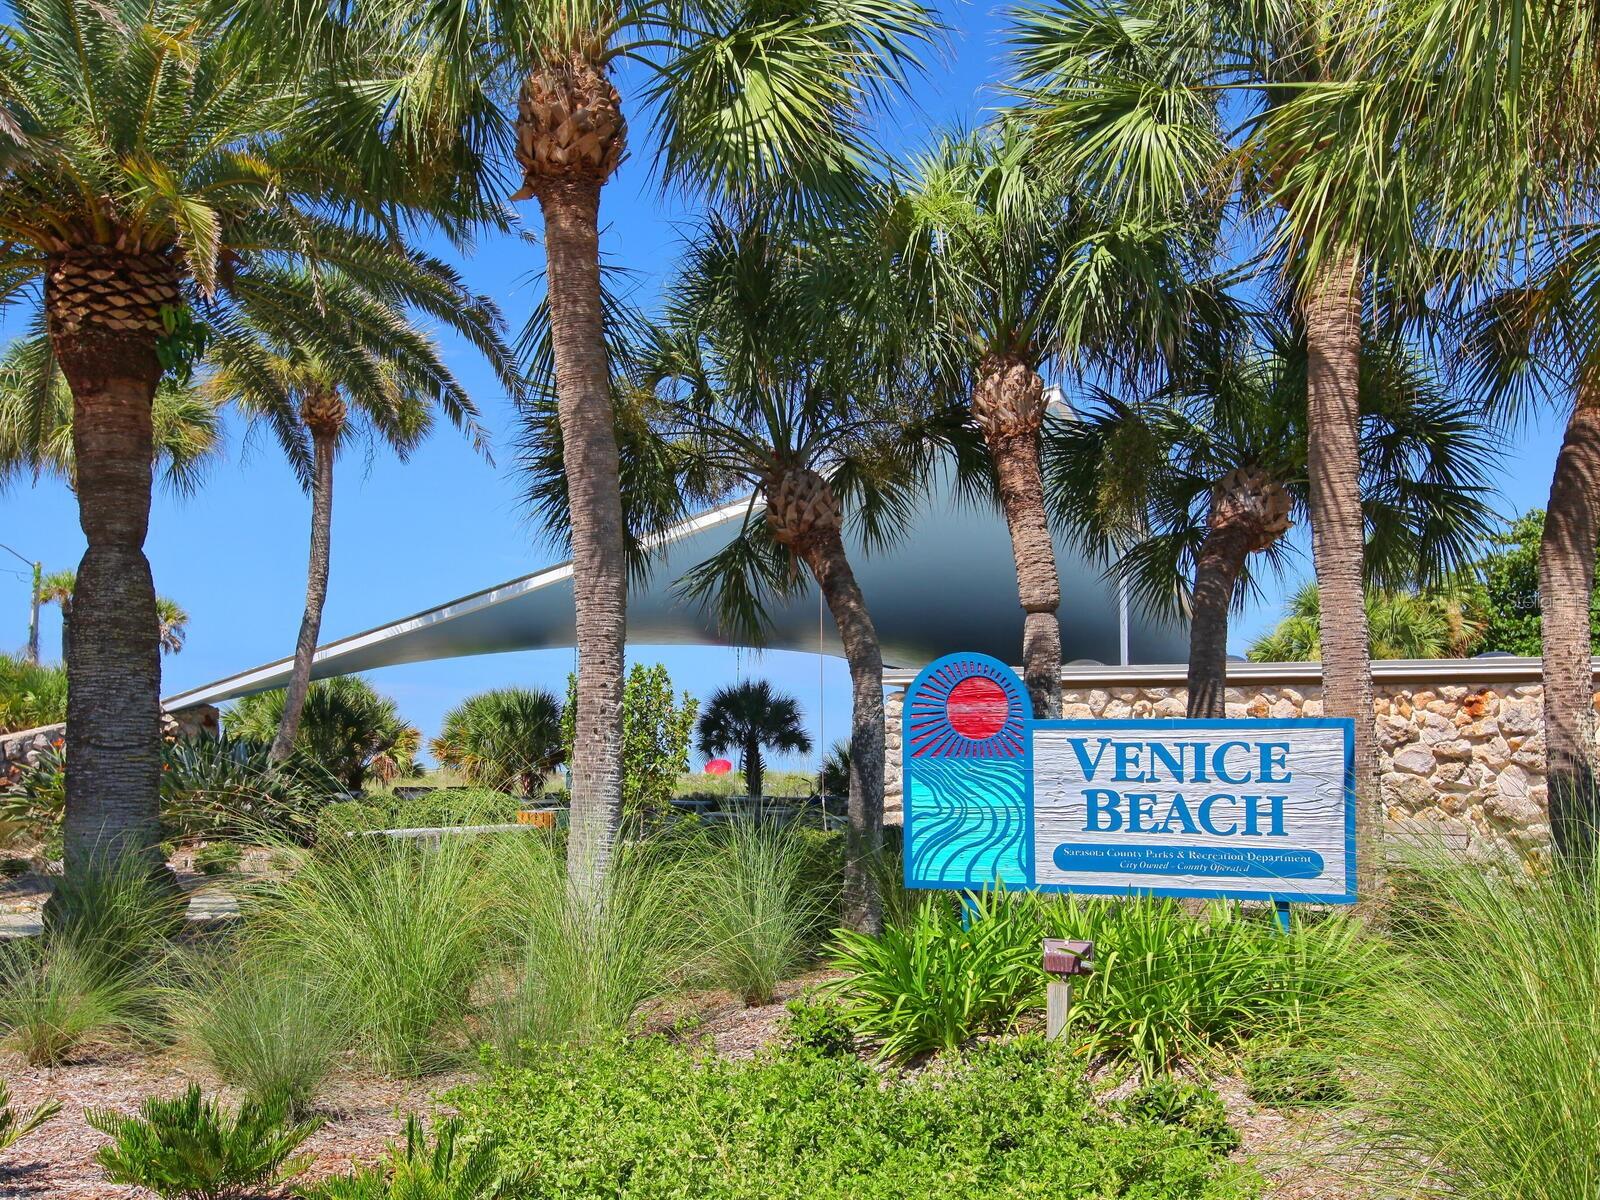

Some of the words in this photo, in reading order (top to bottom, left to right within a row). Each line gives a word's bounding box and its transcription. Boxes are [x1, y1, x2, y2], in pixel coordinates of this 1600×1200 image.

[1067, 738, 1293, 784] VENICE
[1081, 789, 1289, 837] BEACH
[1063, 847, 1104, 857] Sarasota
[1106, 848, 1142, 860] County
[1145, 849, 1174, 859] Parks
[1176, 851, 1185, 859] &
[1189, 850, 1244, 861] Recreation
[1246, 851, 1311, 864] Department
[1119, 860, 1138, 870] City
[1139, 861, 1169, 870] Owned
[1177, 862, 1207, 873] County
[1209, 863, 1250, 873] Operated
